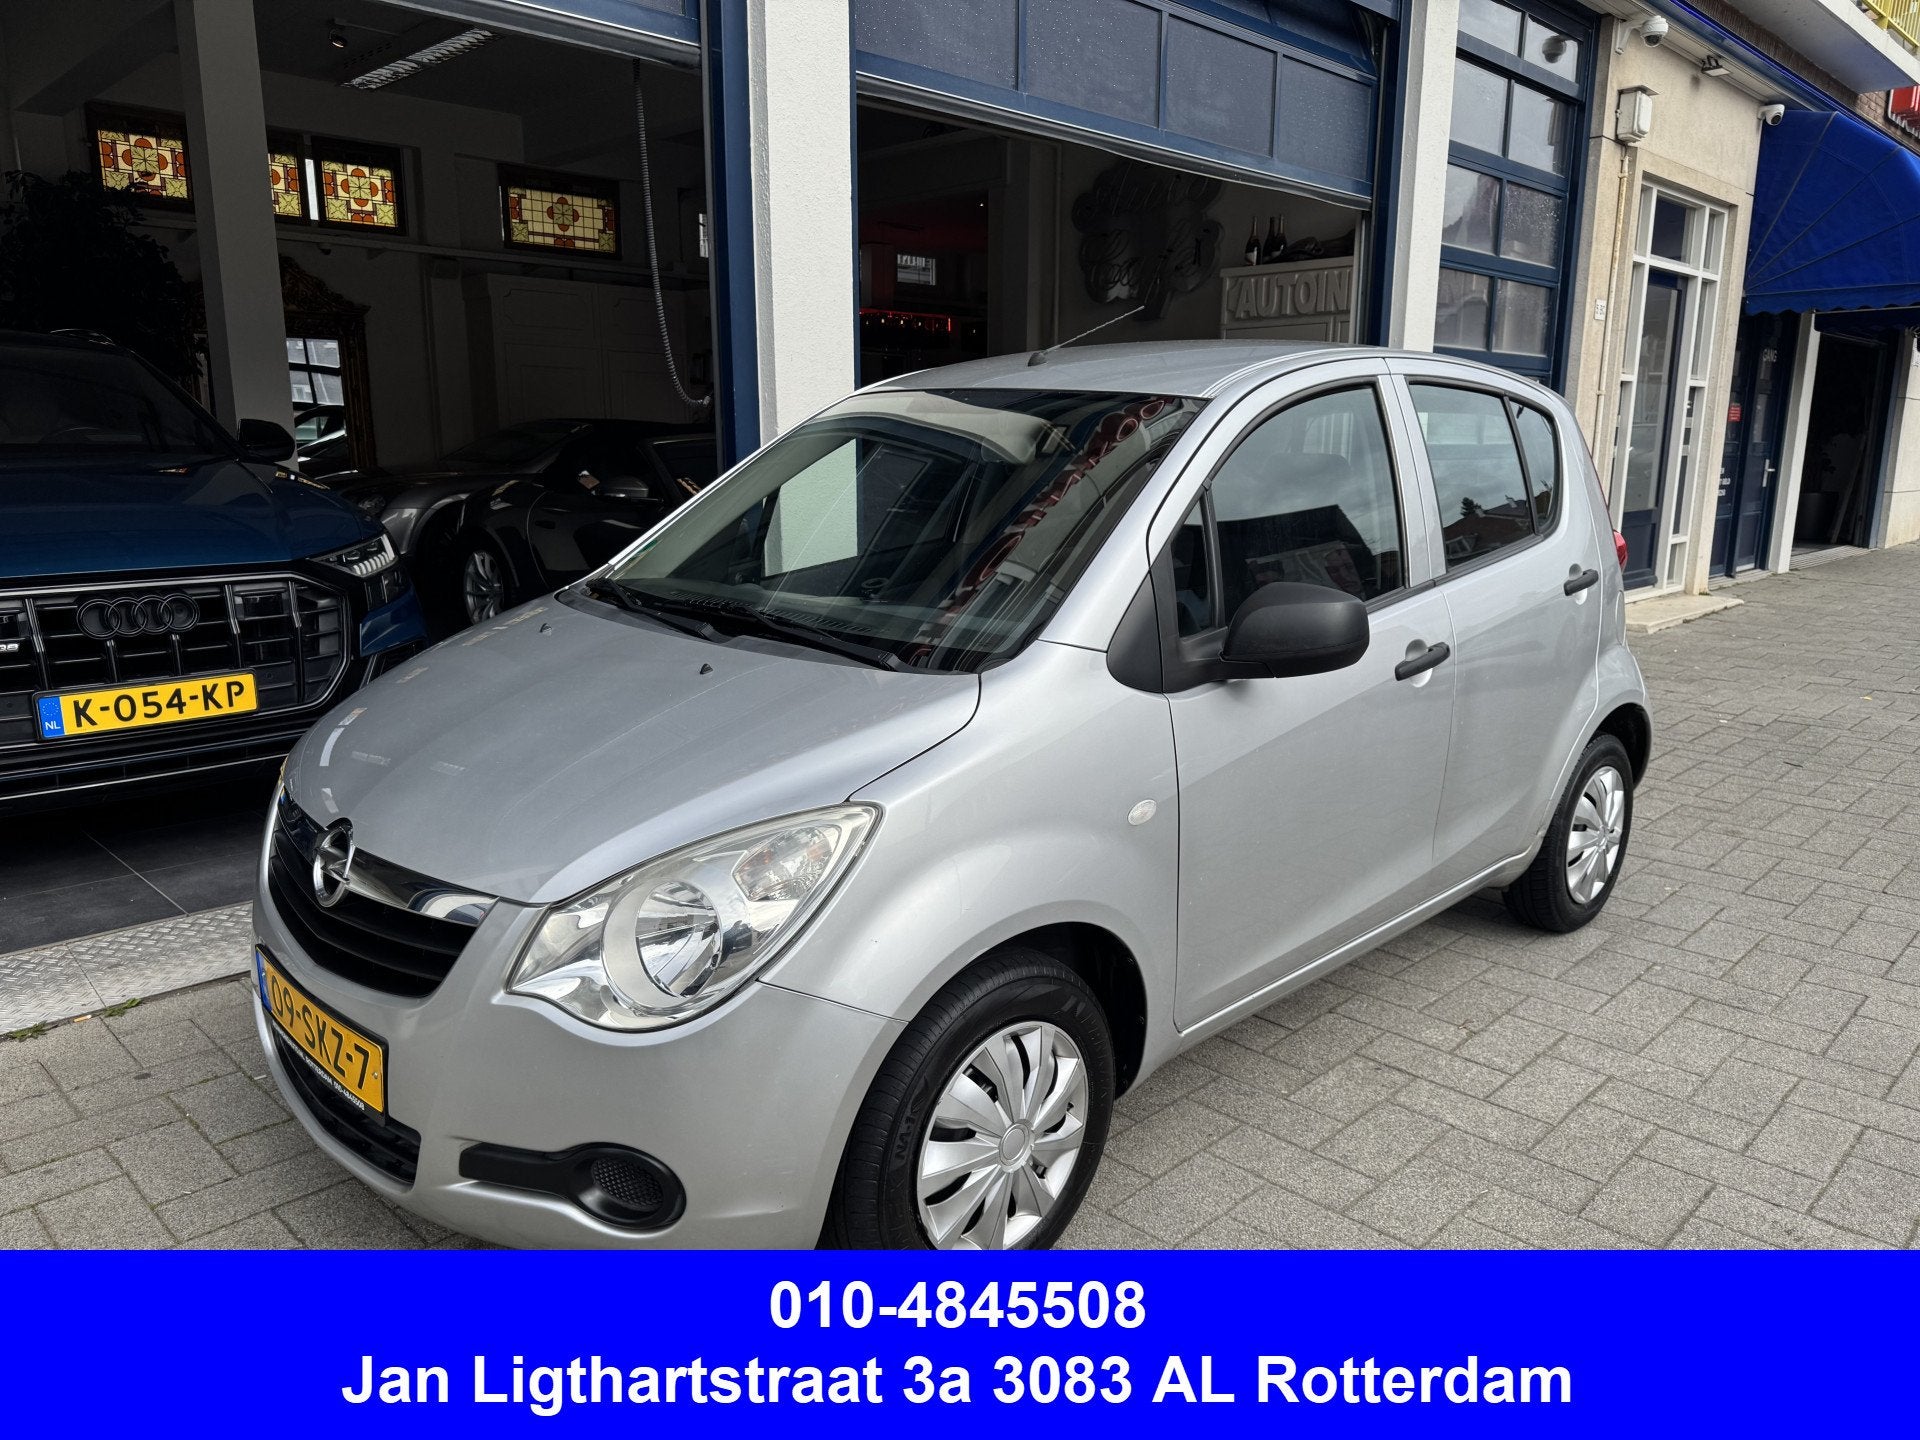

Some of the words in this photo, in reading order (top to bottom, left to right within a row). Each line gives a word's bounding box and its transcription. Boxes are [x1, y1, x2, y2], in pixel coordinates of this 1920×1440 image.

[45, 720, 61, 732] NL
[73, 681, 246, 728] K-054-KP
[271, 975, 370, 1090] 09-SKZ-7
